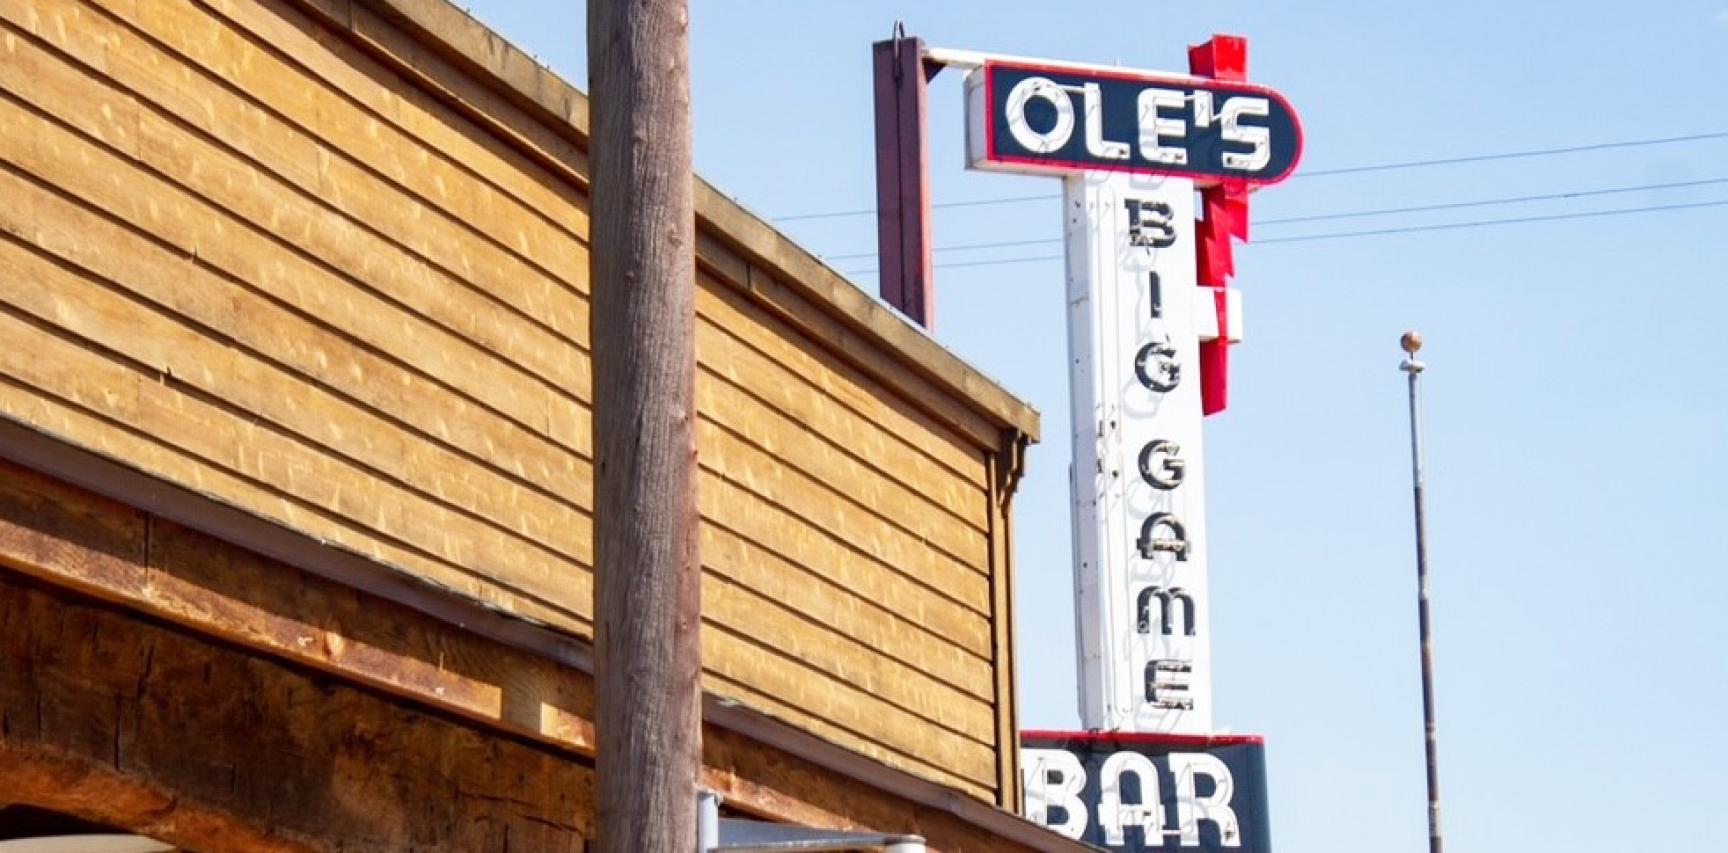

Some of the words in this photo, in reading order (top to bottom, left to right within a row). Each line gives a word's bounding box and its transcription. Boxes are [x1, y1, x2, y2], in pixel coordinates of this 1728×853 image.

[1005, 76, 1271, 171] OLE'S
[1124, 198, 1182, 393] BIG
[1136, 439, 1196, 711] GAME
[1020, 749, 1242, 847] BAR
